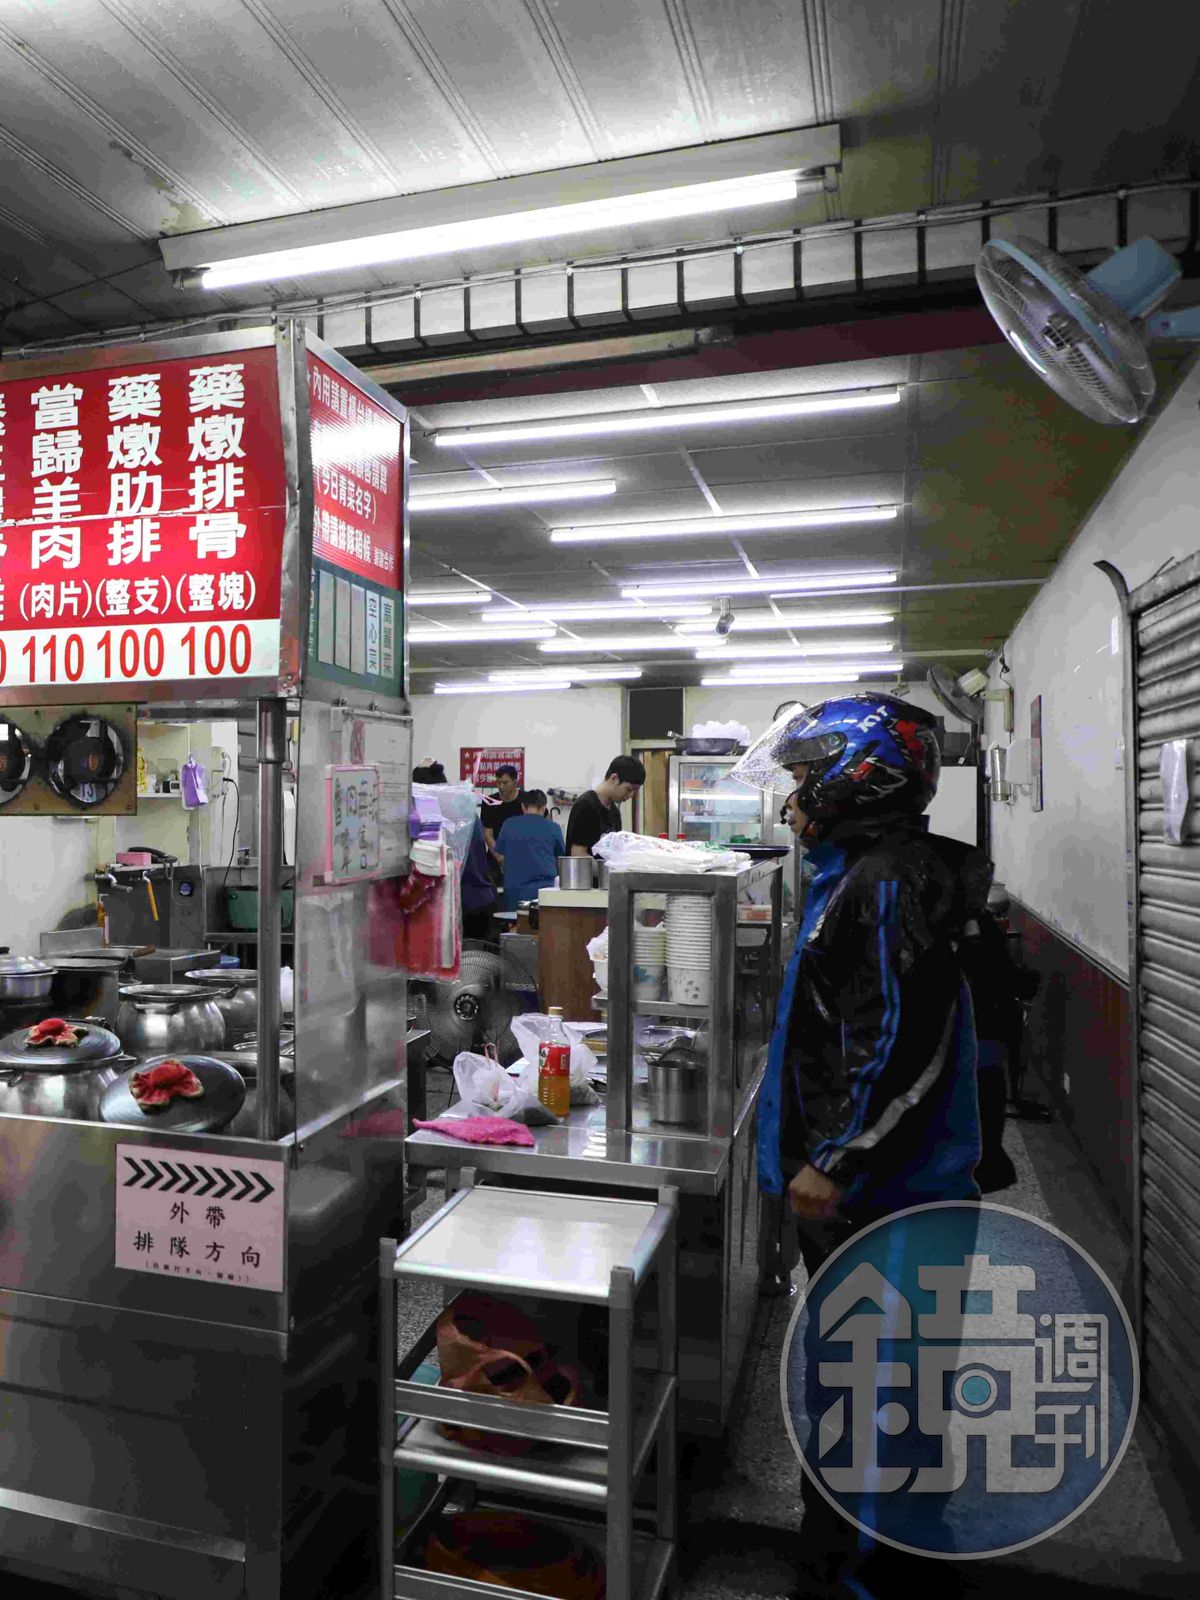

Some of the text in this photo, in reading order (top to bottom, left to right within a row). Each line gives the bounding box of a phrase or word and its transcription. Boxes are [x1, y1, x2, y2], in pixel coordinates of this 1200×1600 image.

[30, 384, 84, 570] 當歸羊肉
[106, 374, 162, 566] 藥燉肋排
[187, 363, 246, 560] 藥燉排骨
[19, 580, 93, 621] (肉片)
[96, 575, 172, 617] (整支)
[176, 571, 256, 613] (整塊)
[23, 634, 84, 683] 110
[97, 629, 165, 679] 100
[181, 624, 252, 676] 100
[856, 705, 888, 733] KYT
[170, 1201, 226, 1229] 外帶
[133, 1230, 261, 1269] 排隊方向
